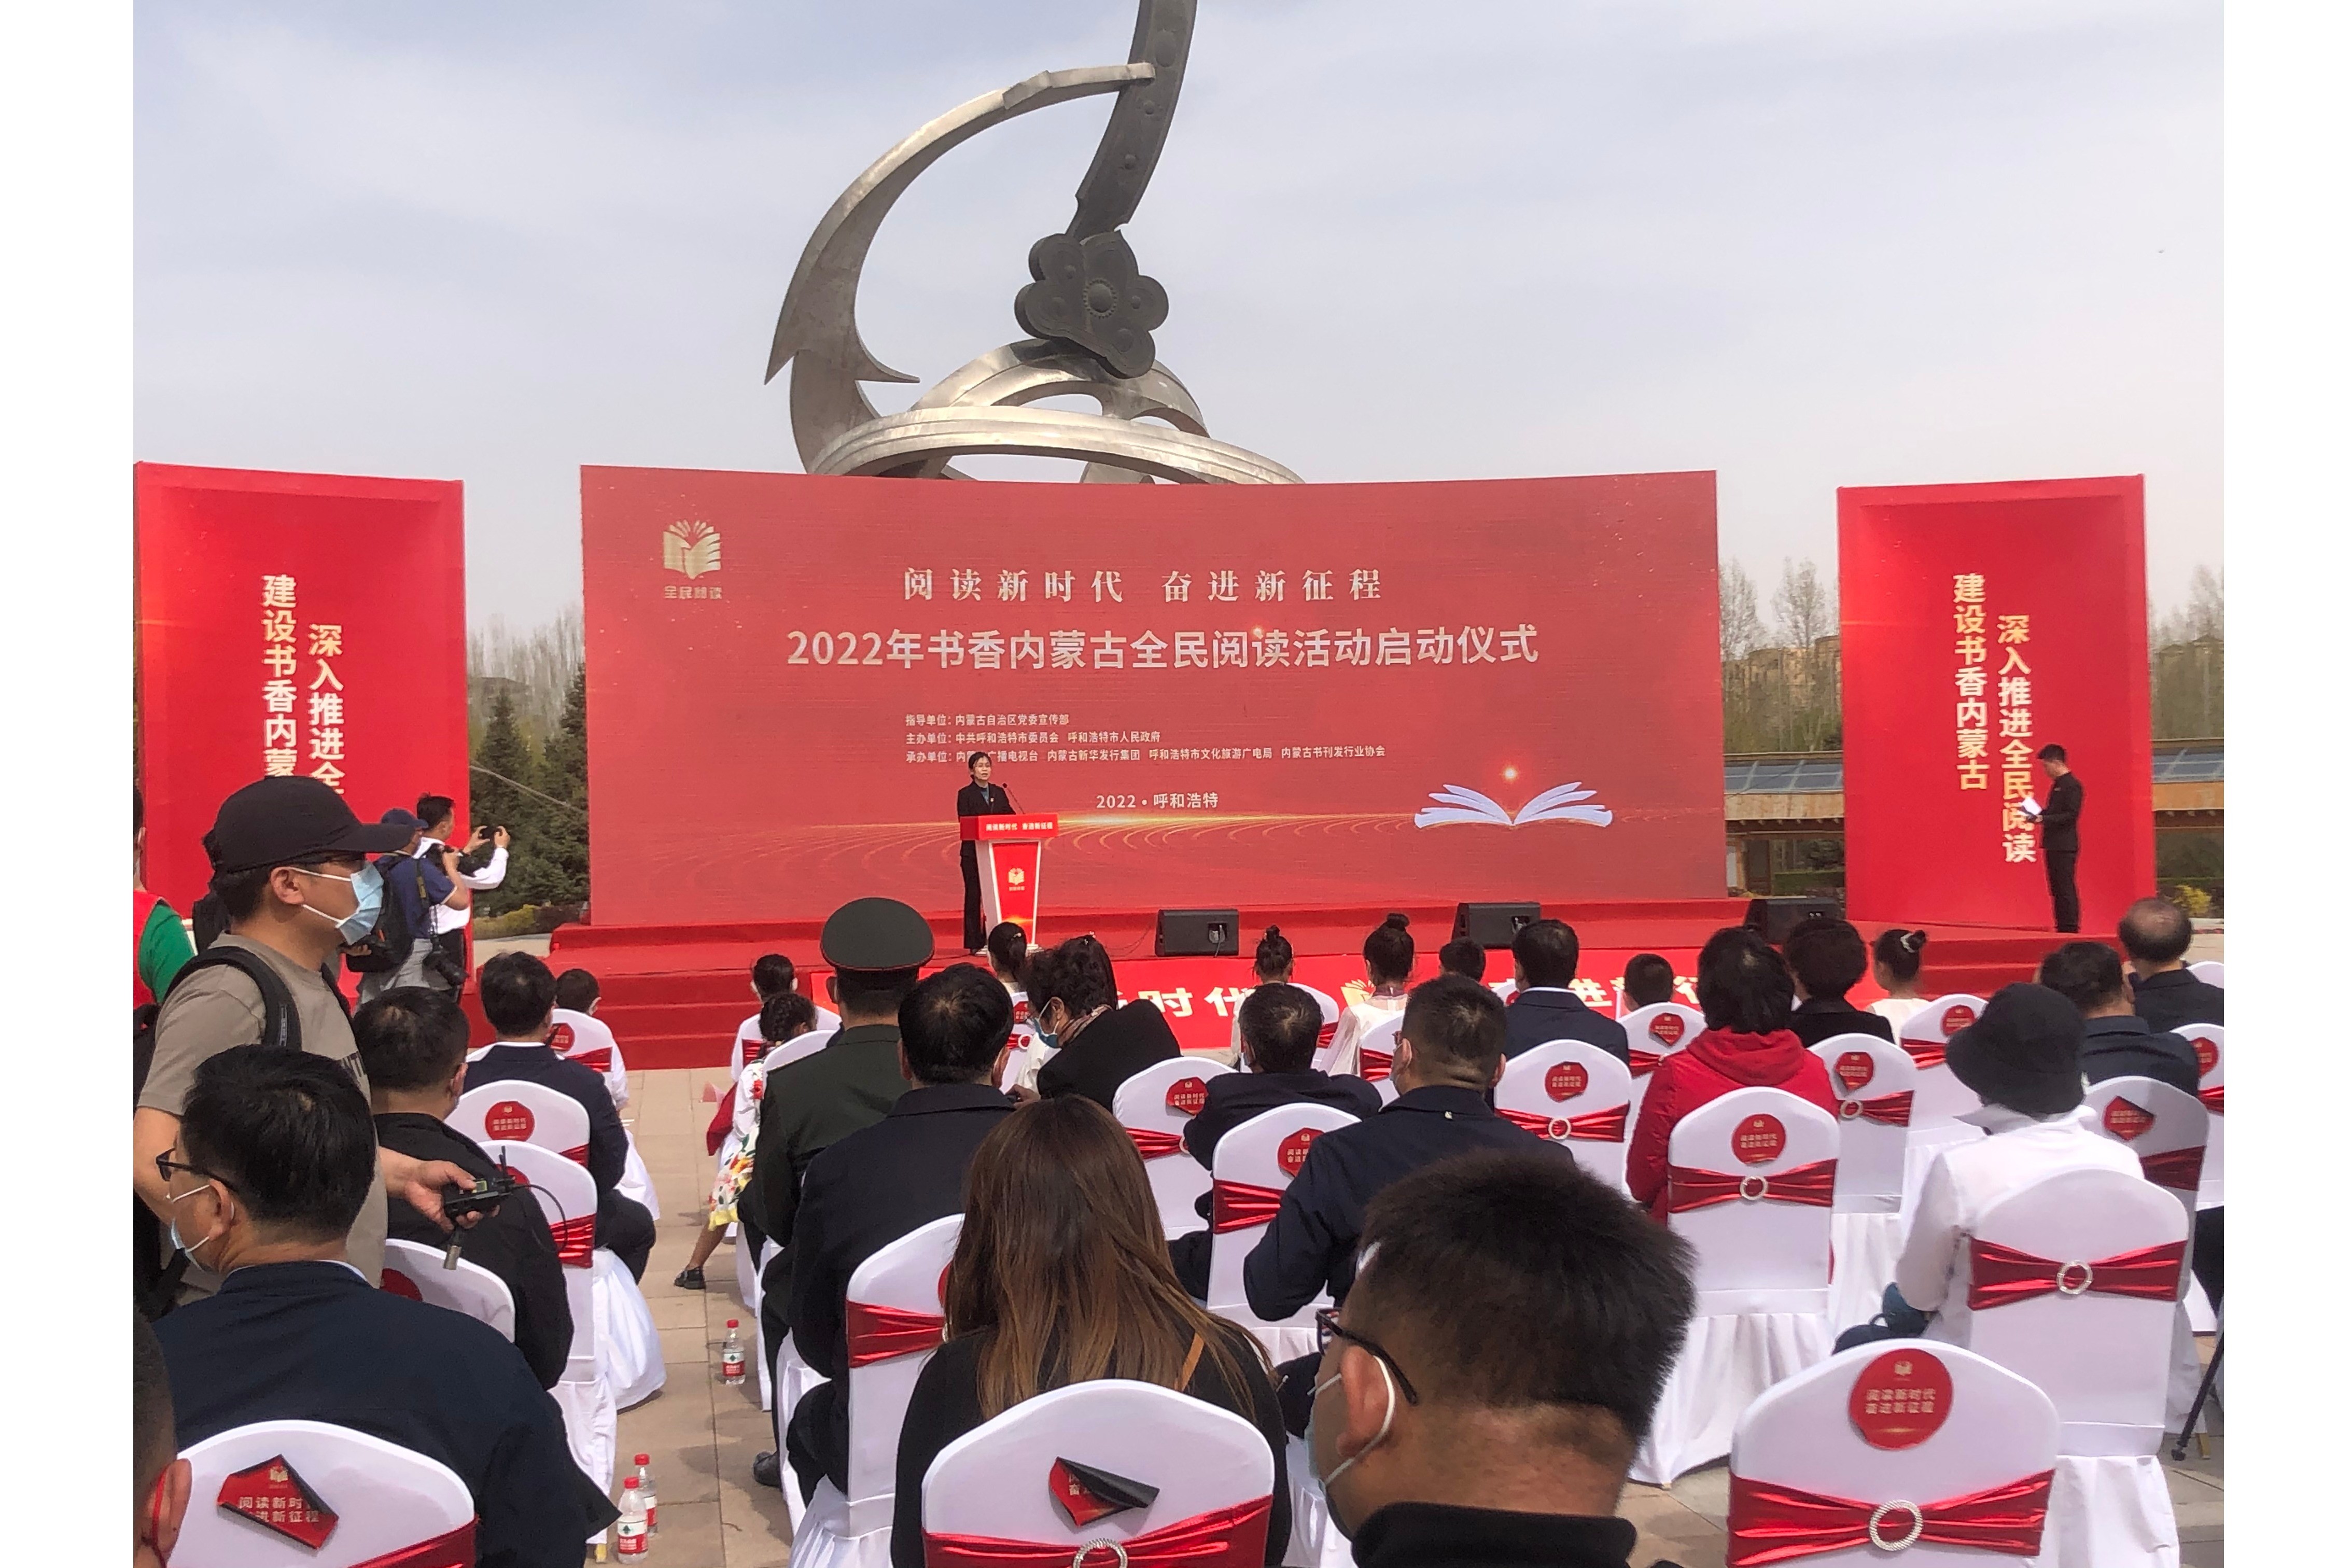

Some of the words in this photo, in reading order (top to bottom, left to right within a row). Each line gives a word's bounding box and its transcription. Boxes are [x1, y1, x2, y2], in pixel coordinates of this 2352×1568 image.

[904, 567, 1123, 603] 阅读新时代
[1162, 568, 1381, 603] 奋进新征程
[787, 623, 1539, 669] 2022年书香内蒙古全民阅读活动启动仪式
[1953, 572, 1990, 790] 建设书香内蒙古
[1068, 731, 1160, 743] 呼和浩特市人民政府
[1997, 614, 2037, 863] 深入推进全民阅读
[1047, 749, 1140, 762] 内蒙古新华发行集团
[1149, 748, 1272, 761] 呼和浩特市文化旅游广电局
[1281, 745, 1385, 759] 内蒙古书刊发行业协会
[239, 1496, 311, 1508] 阅读新时
[250, 1510, 319, 1522] 进新征程
